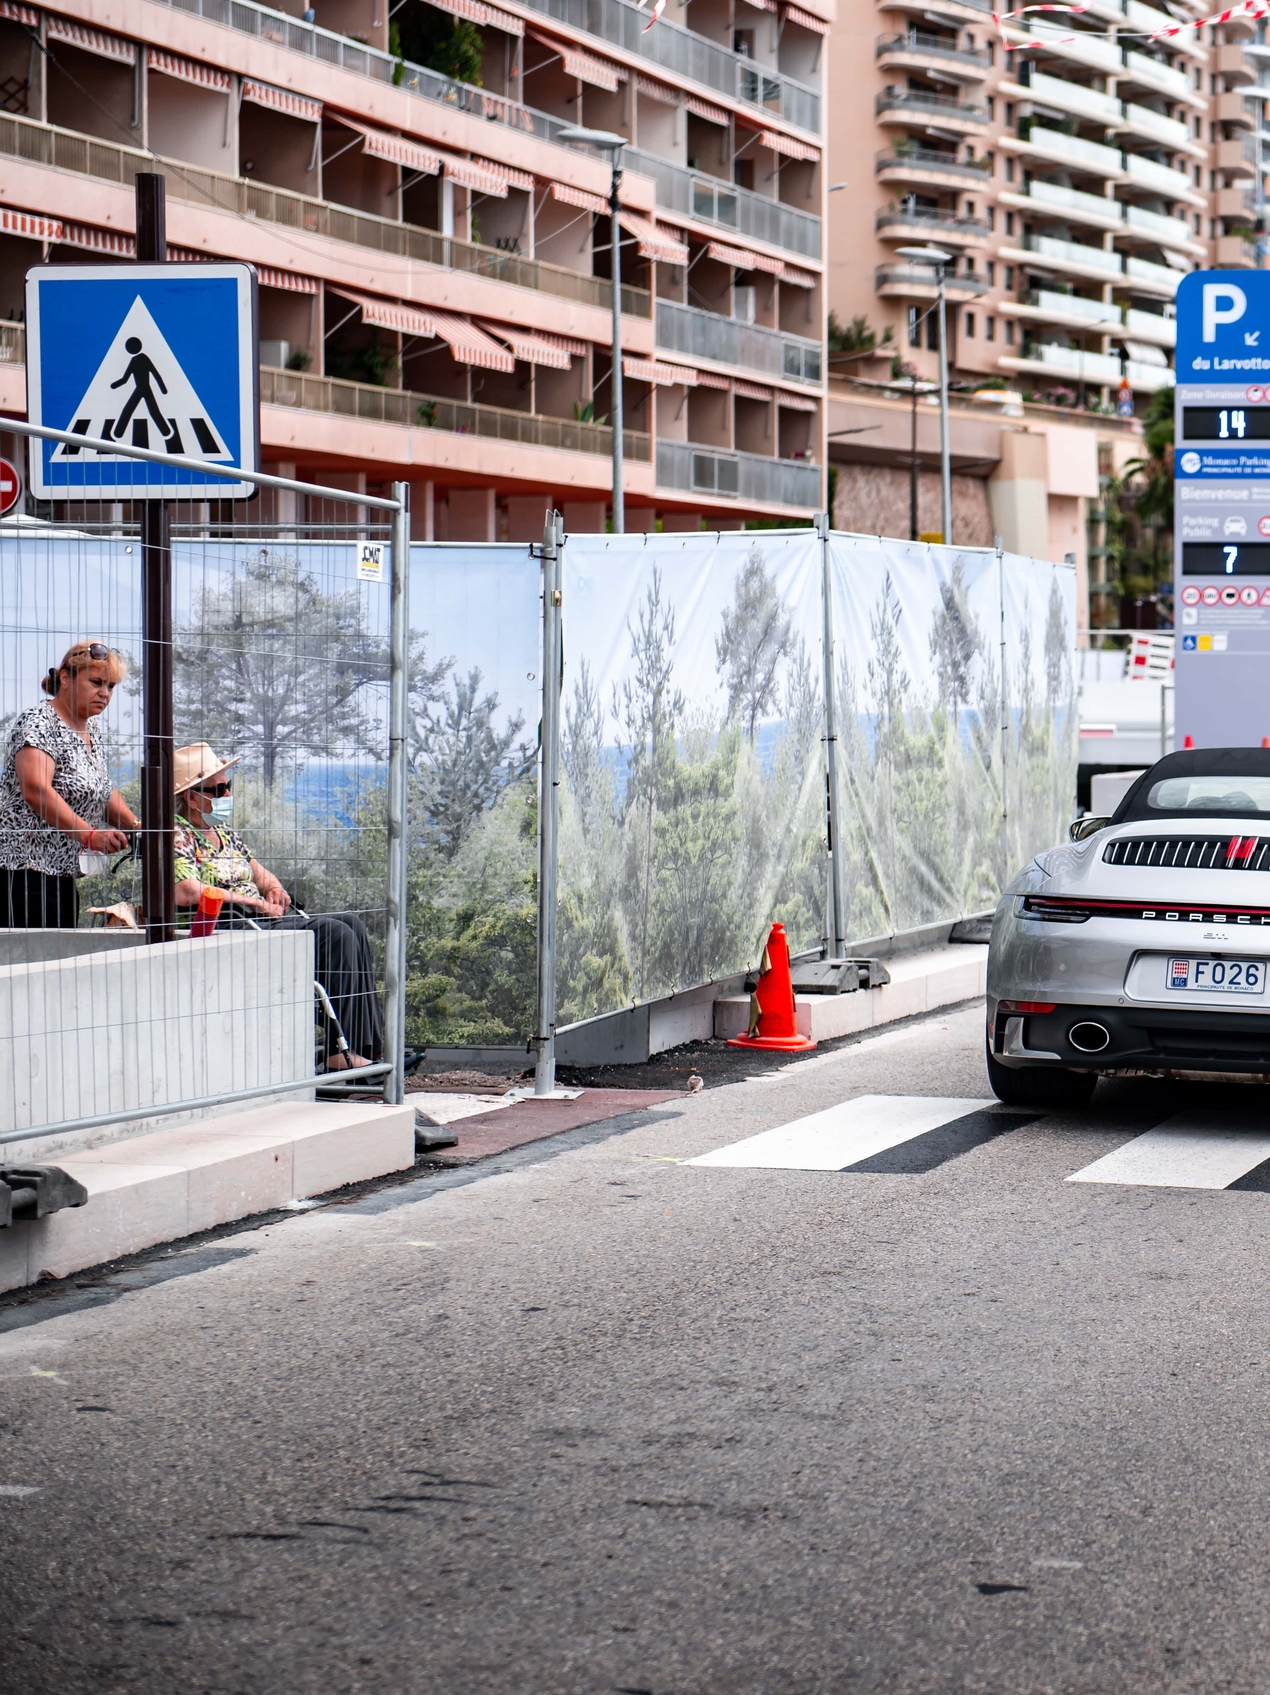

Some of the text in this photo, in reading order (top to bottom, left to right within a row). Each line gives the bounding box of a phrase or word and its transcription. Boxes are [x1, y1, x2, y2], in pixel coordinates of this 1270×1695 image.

[1203, 283, 1247, 343] P
[1192, 356, 1210, 370] du
[1218, 410, 1246, 438] 14
[1202, 456, 1238, 466] Monaco
[1180, 486, 1250, 500] Bienvenue
[1182, 516, 1220, 528] Parking
[1182, 527, 1213, 537] Public
[1223, 546, 1238, 574] 7
[1194, 961, 1260, 986] F026
[1174, 977, 1186, 986] MC
